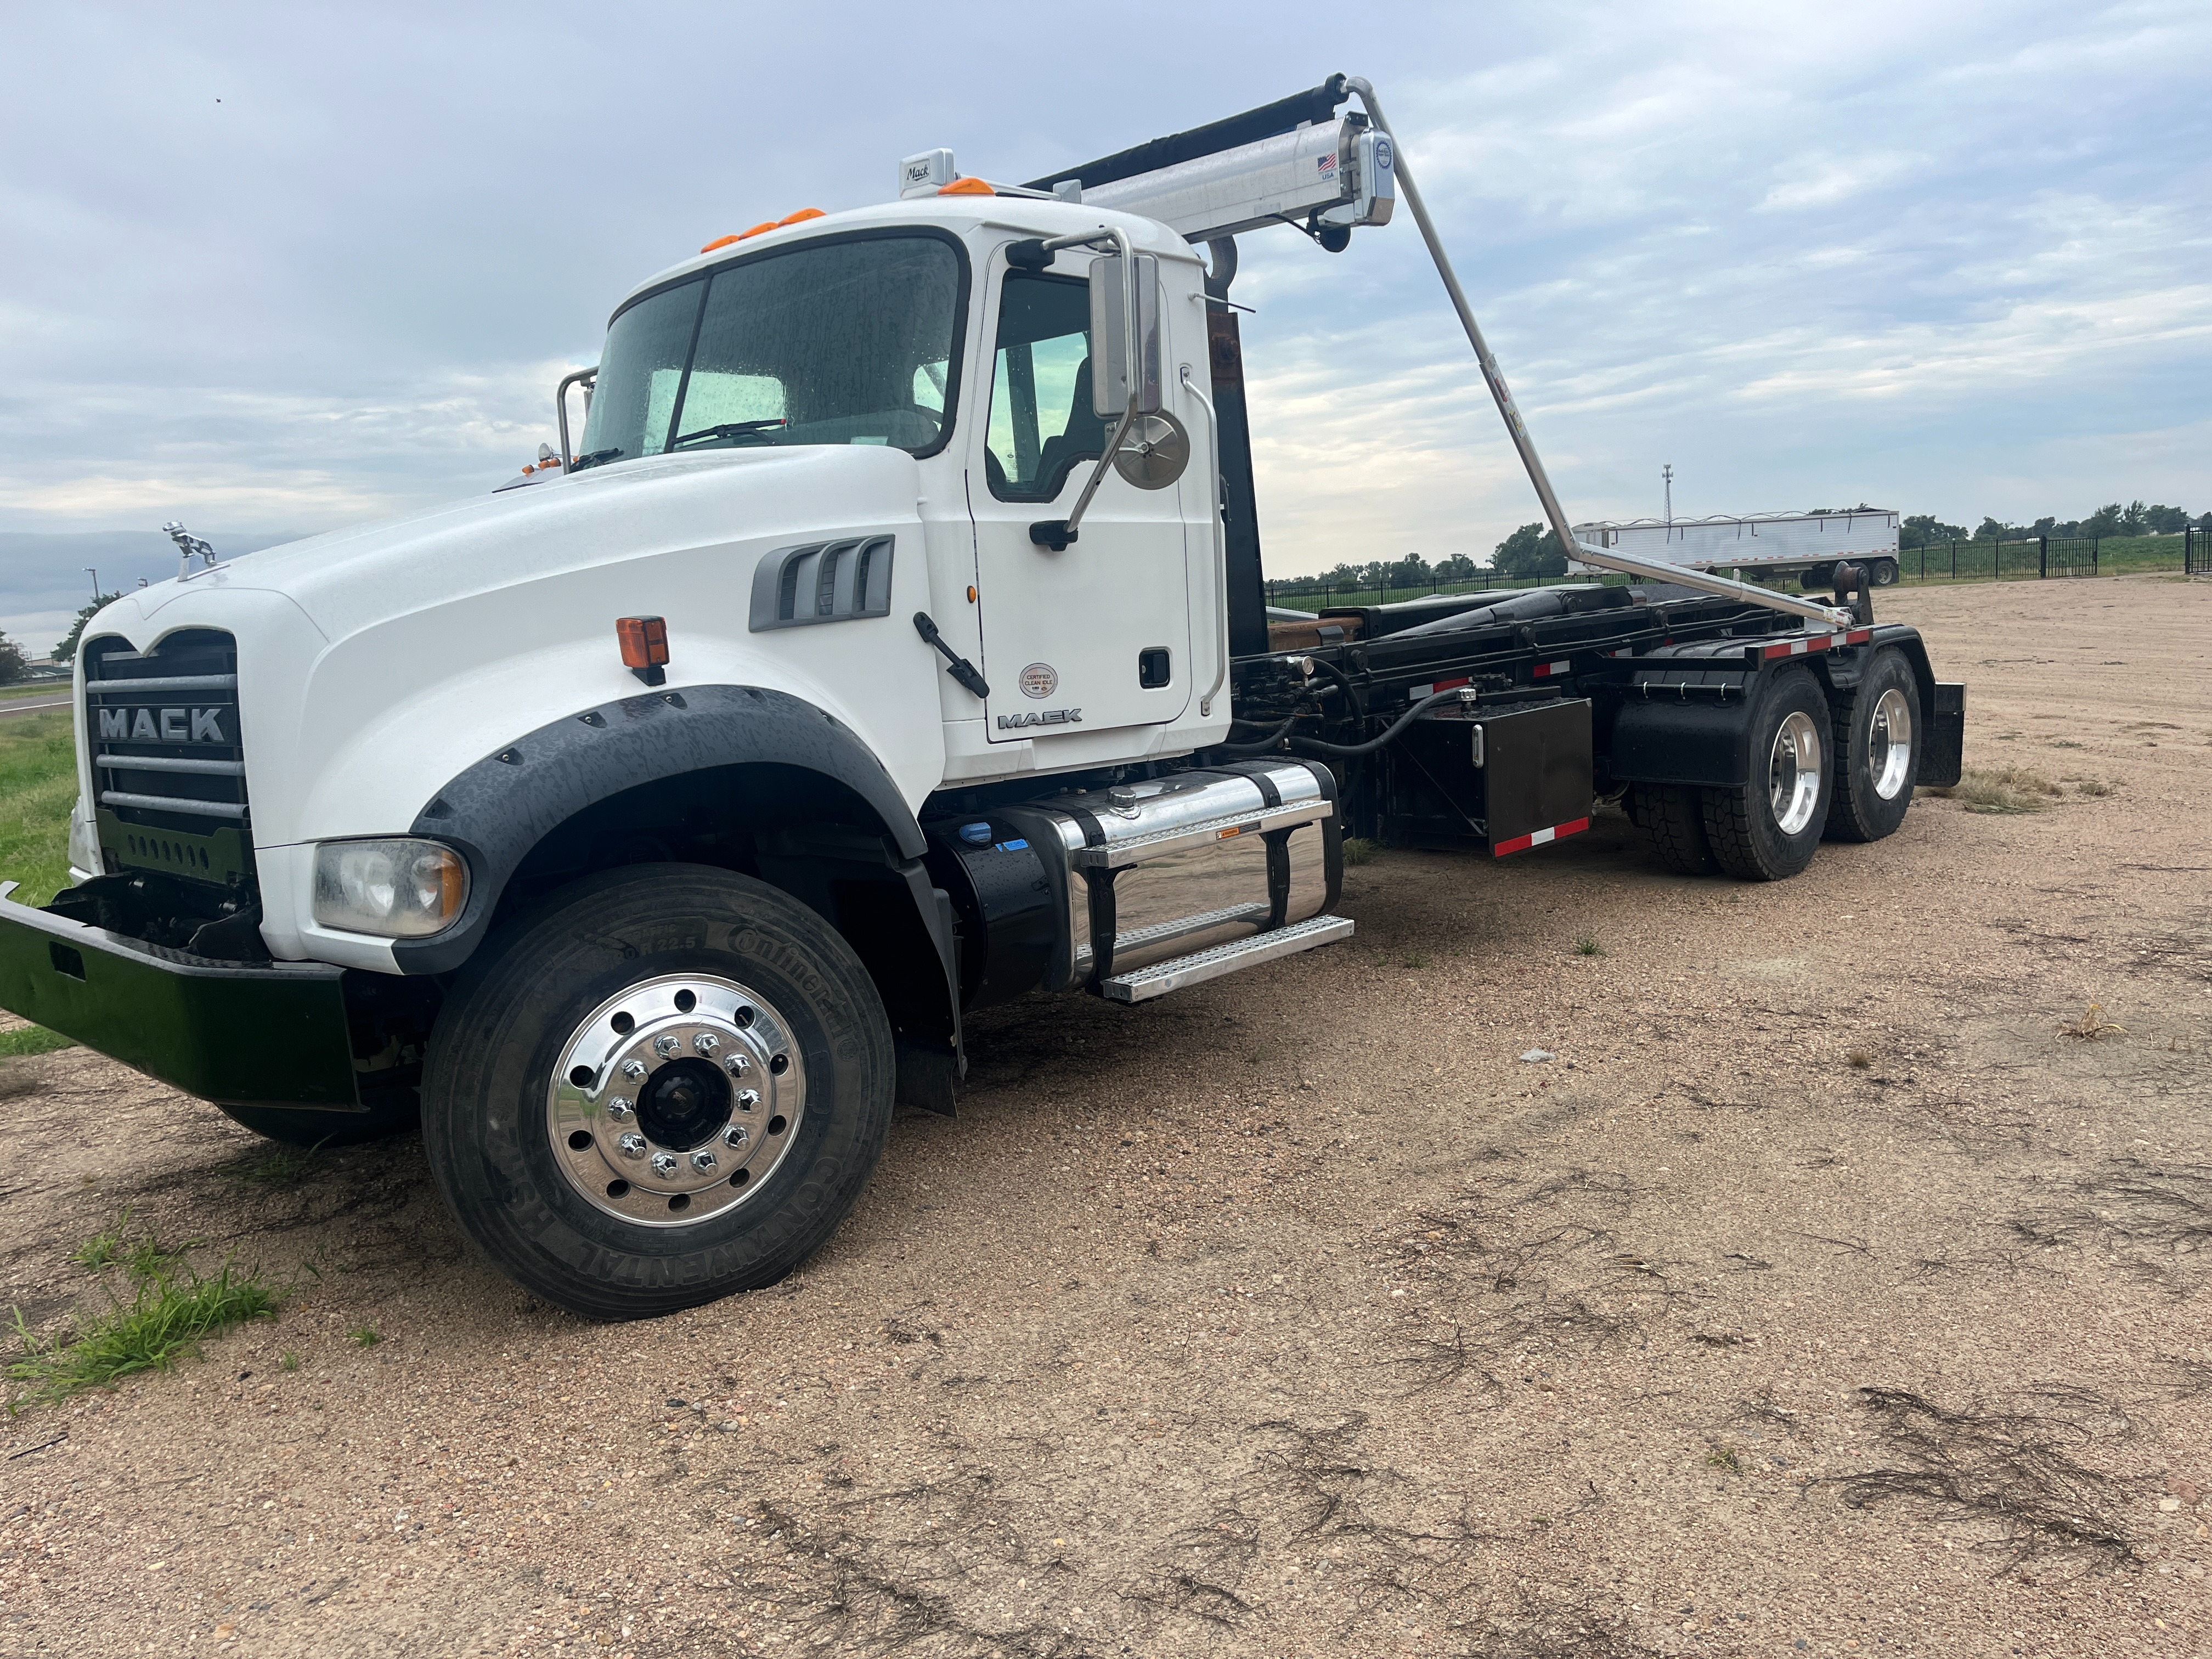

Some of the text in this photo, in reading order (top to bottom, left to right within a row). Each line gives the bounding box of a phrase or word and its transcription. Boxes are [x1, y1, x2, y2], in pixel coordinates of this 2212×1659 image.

[906, 163, 929, 181] Mack
[1322, 172, 1334, 180] USA
[98, 708, 225, 743] MACK
[997, 708, 1083, 730] MACK
[657, 936, 696, 952] 22.5
[727, 924, 855, 1040] Continental
[574, 1156, 843, 1289] CONTINENTAL
